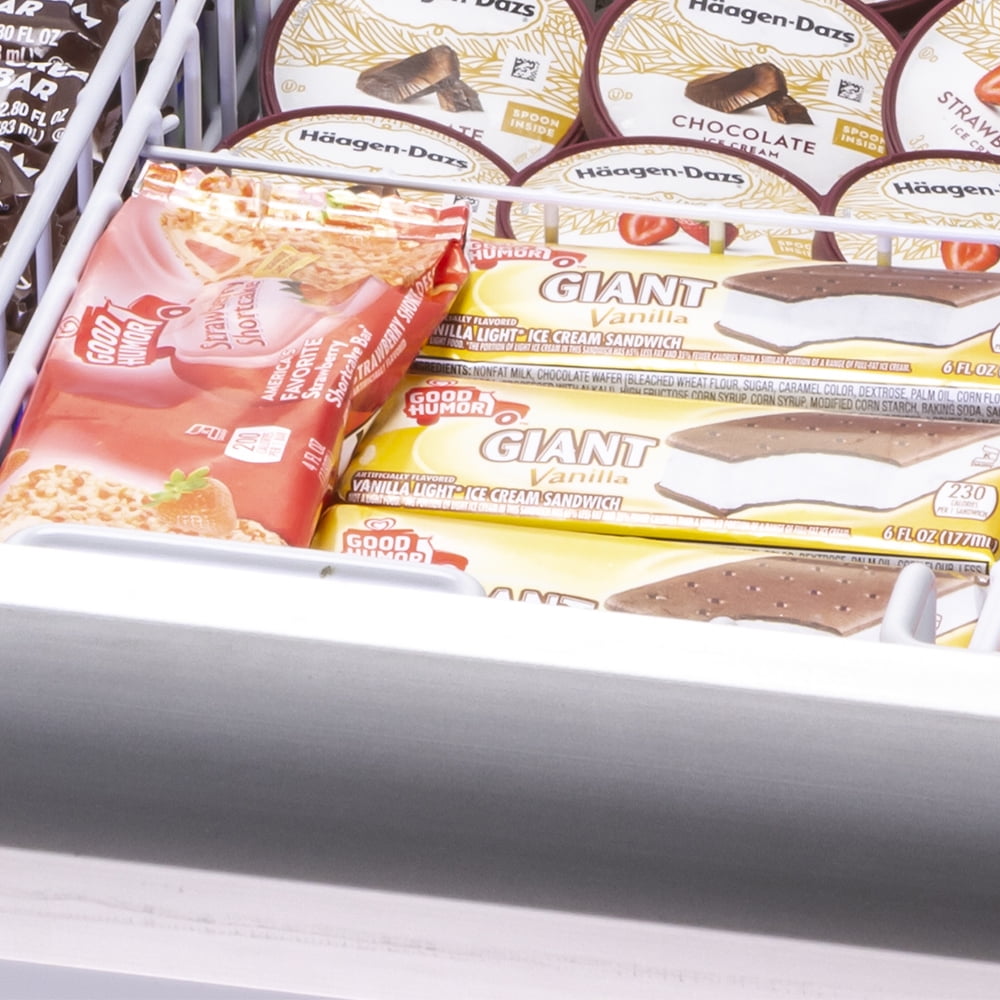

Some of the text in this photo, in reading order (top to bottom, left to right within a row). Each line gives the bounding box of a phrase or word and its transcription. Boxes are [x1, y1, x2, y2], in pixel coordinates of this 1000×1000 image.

[17, 27, 35, 43] FL
[39, 28, 61, 47] OZ
[31, 109, 47, 127] FL
[51, 108, 69, 123] OZ
[509, 118, 556, 138] INSIDE
[511, 108, 560, 127] SPOON
[672, 114, 817, 155] CHOCOLATE
[950, 124, 970, 140] ICE
[299, 129, 468, 169] Häagen-Dazs
[575, 166, 745, 185] Häagen-Dazs
[540, 271, 717, 308] GIANT
[473, 317, 517, 326] FLAVORED
[590, 306, 689, 328] Vanilla
[86, 315, 122, 364] GOOD
[117, 318, 163, 365] HUMOR
[528, 329, 549, 343] ICE
[552, 330, 601, 345] CREAM
[604, 332, 683, 350] SANDWICH
[352, 317, 405, 385] TRAWBERRY
[280, 337, 323, 401] FAVORITE
[301, 339, 349, 400] Strawberry
[325, 350, 363, 408] Shortcake
[942, 360, 953, 374] 6
[956, 362, 972, 376] FL
[976, 364, 995, 377] OZ
[473, 366, 508, 378] NONFAT
[510, 367, 533, 380] MILK,
[537, 369, 590, 383] CHOCOLATE
[591, 372, 623, 384] WAFER
[676, 377, 707, 389] WHEAT
[709, 378, 739, 391] FLOUR,
[743, 380, 775, 393] SUGAR,
[778, 382, 821, 395] CARAMEL
[824, 384, 856, 397] COLOR,
[859, 386, 907, 400] DEXTROSE,
[910, 389, 936, 400] PALM
[956, 391, 982, 403] CORN
[409, 390, 472, 404] GOOD
[691, 390, 717, 401] CORN
[751, 393, 776, 405] CORN
[810, 397, 853, 410] MODIFIED
[855, 399, 880, 411] CORN
[883, 401, 920, 414] STARCH,
[922, 402, 956, 415] BAKING
[409, 401, 485, 416] HUMOR
[232, 432, 260, 454] 200
[480, 428, 659, 468] GIANT
[355, 472, 456, 483] ARTIFICIALLY FLAVORED
[529, 467, 629, 488] Vanilla
[352, 479, 409, 495] VANILLA
[465, 486, 487, 500] ICE
[489, 488, 541, 506] CREAM
[543, 491, 622, 511] SANDWICH
[948, 484, 986, 500] 230
[347, 533, 411, 551] GOOD
[883, 525, 893, 540] 6
[898, 527, 913, 542] FL
[917, 530, 938, 544] OZ
